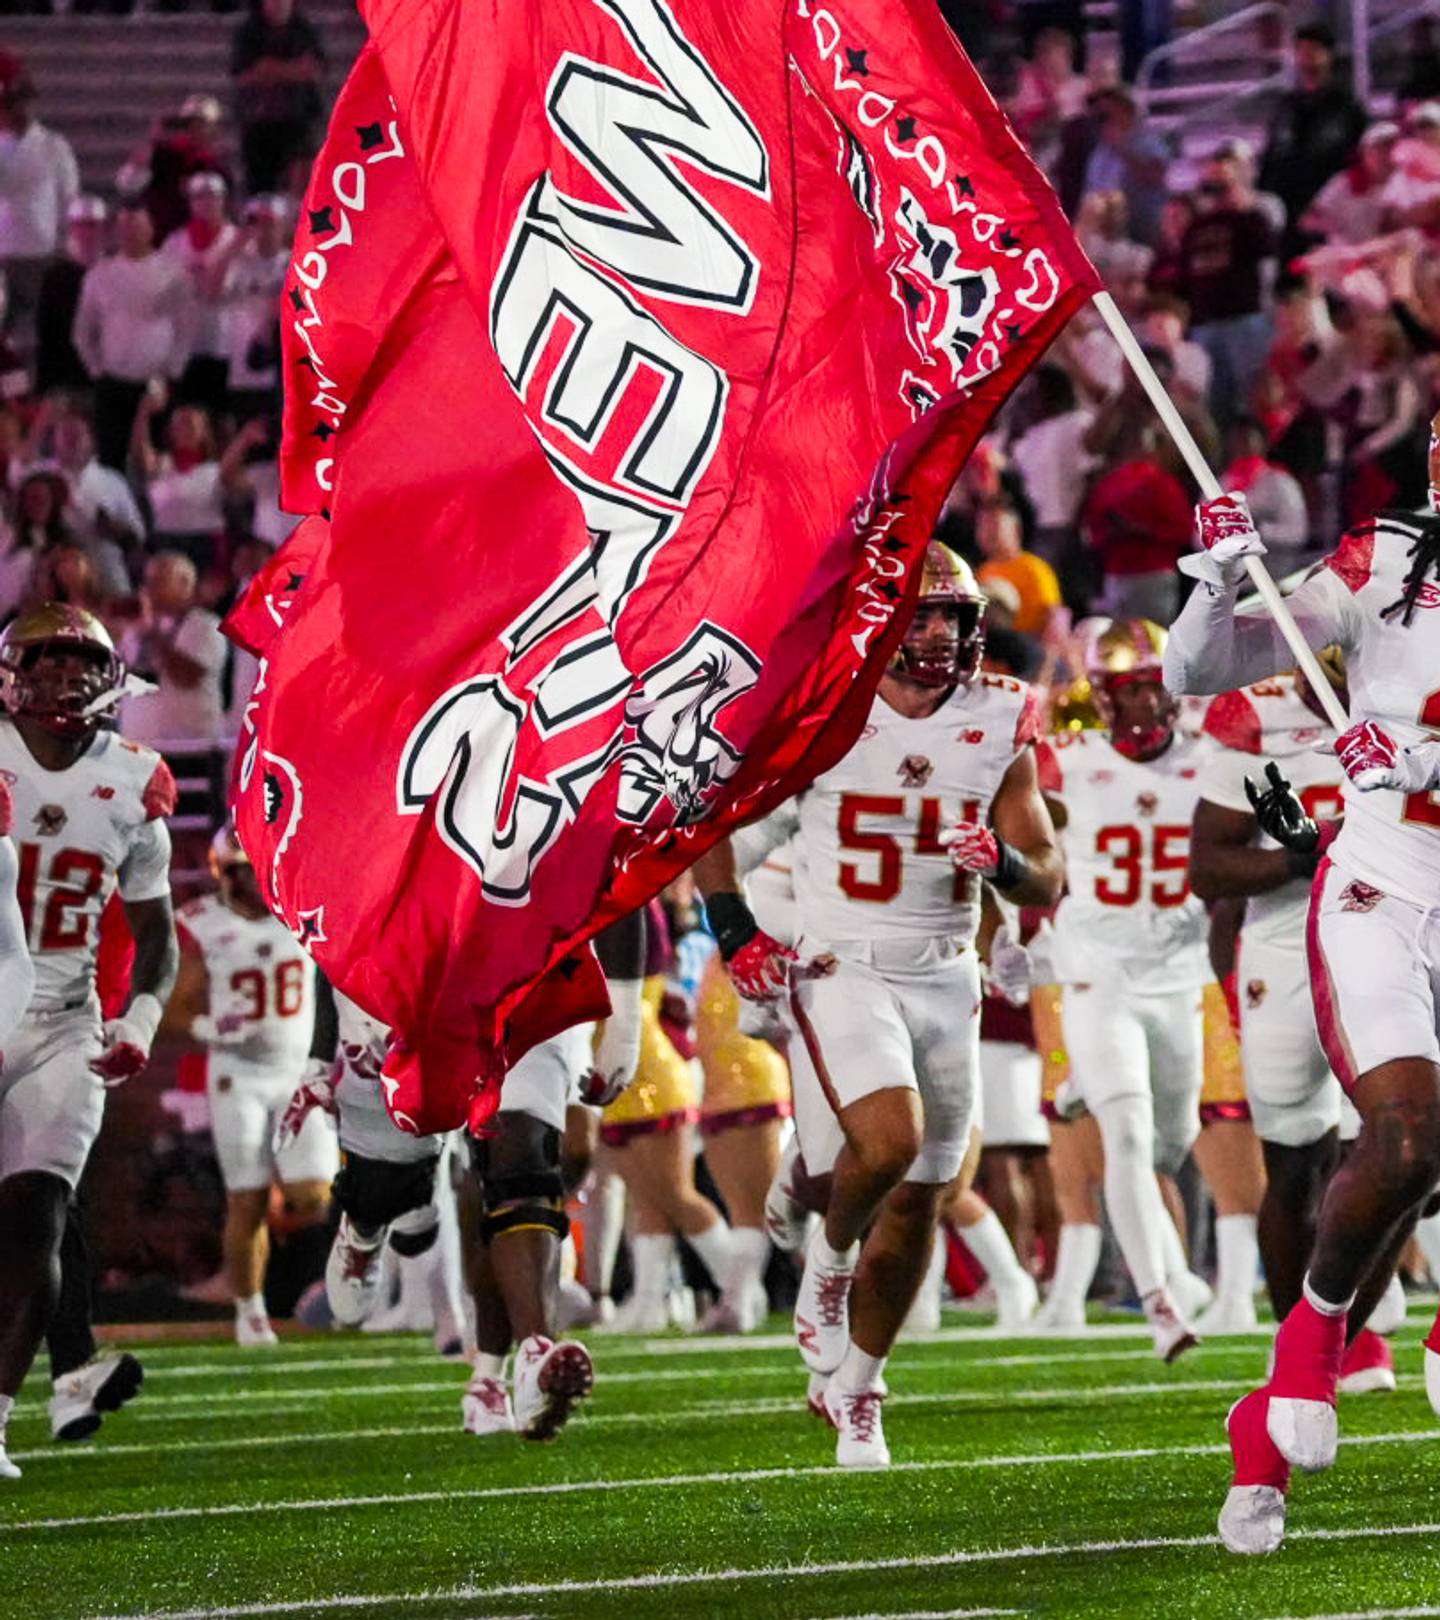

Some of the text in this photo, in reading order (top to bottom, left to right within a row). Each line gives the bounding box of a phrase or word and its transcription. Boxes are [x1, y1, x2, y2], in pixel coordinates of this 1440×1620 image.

[17, 841, 106, 953] 12
[838, 792, 981, 904] 54
[1094, 824, 1193, 909] 35
